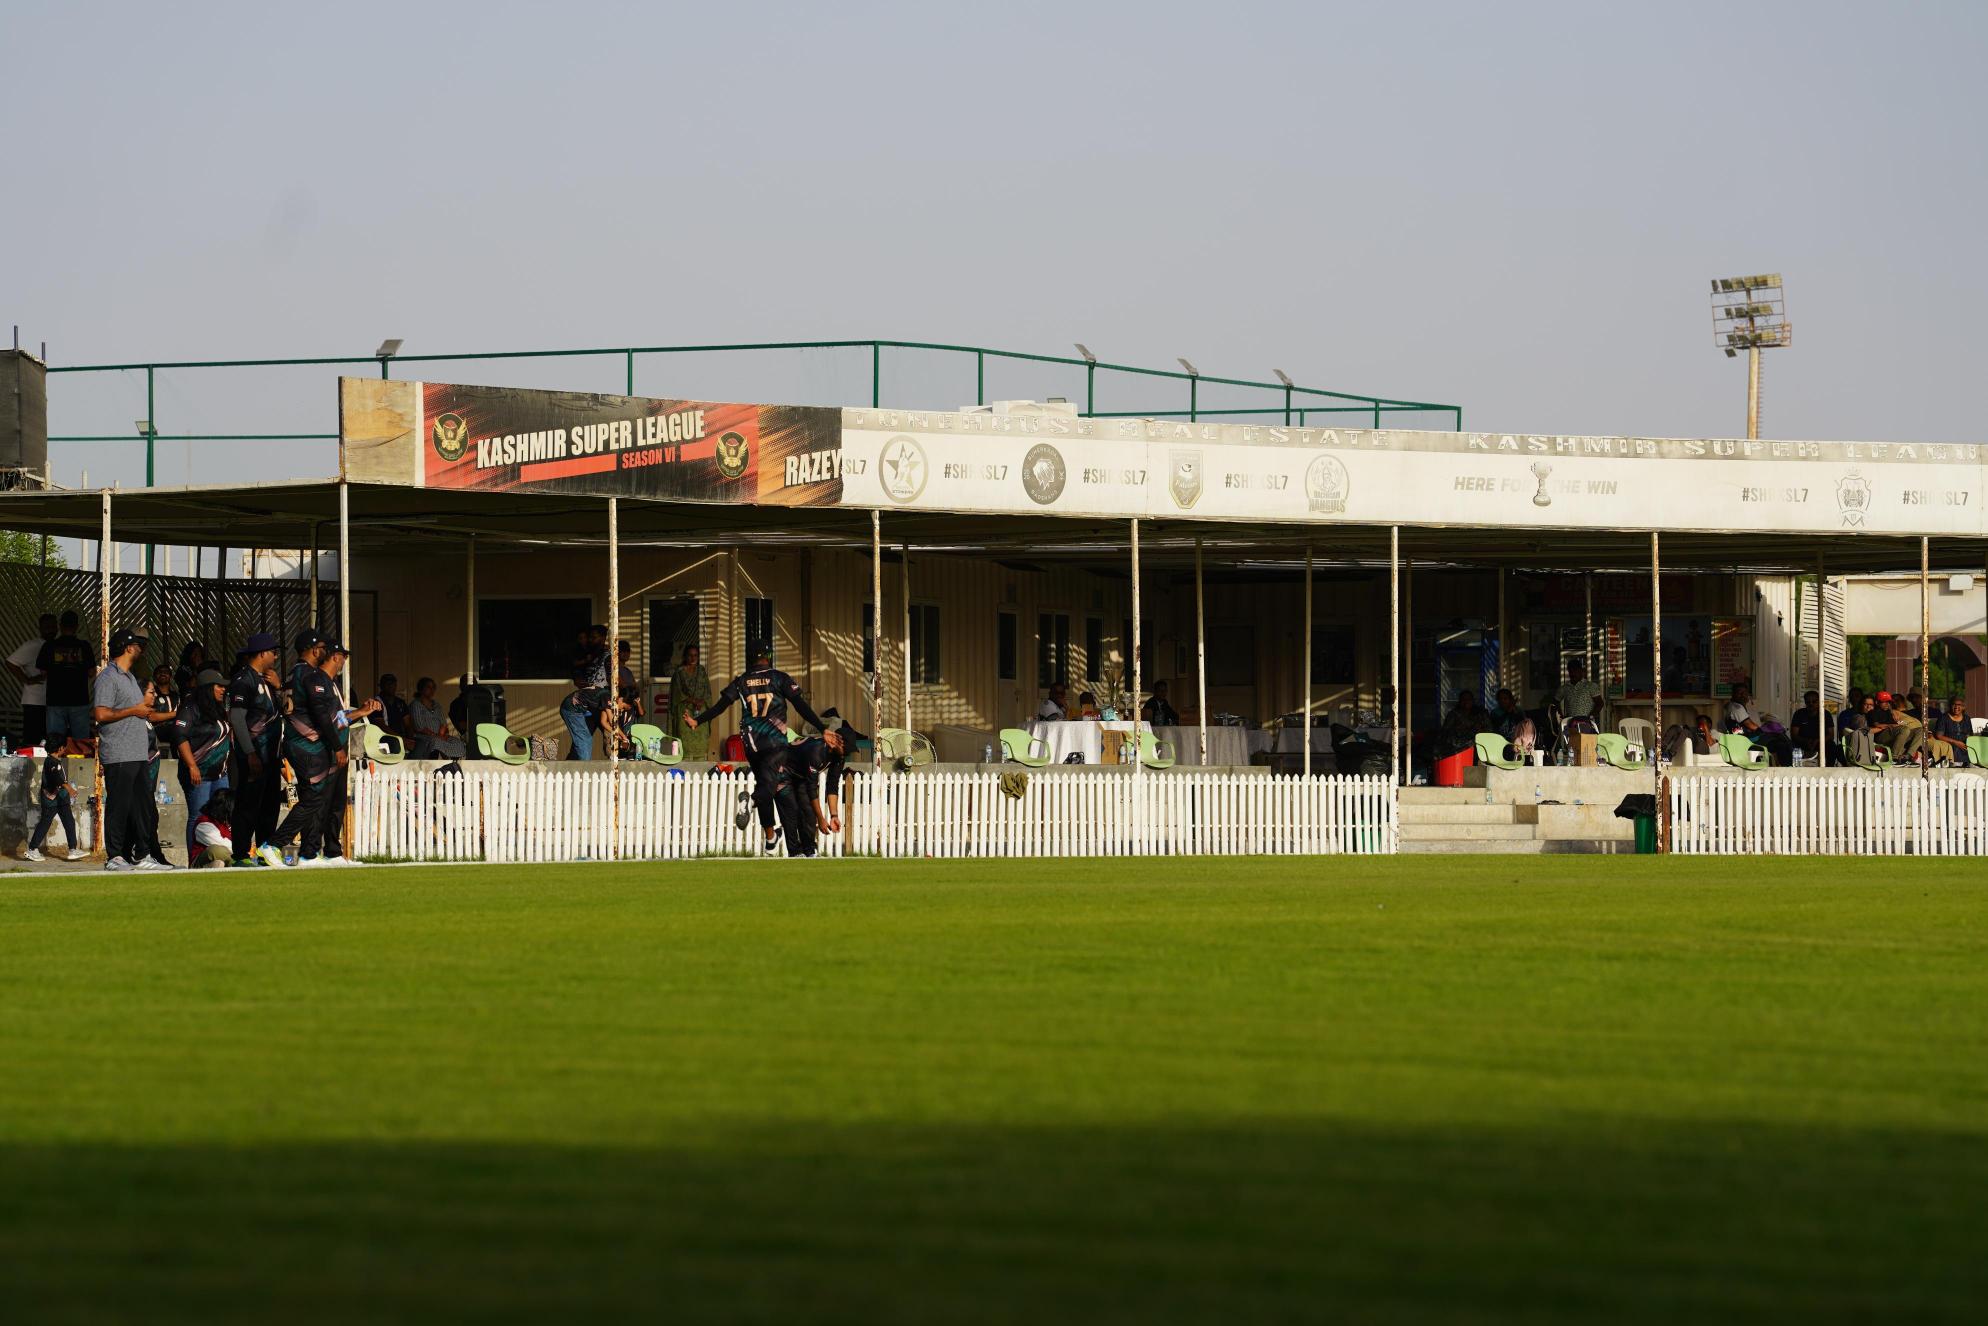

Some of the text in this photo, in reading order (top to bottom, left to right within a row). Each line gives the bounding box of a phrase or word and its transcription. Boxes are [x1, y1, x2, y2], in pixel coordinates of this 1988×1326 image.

[477, 410, 705, 469] KASHMIR SUPER LEAGUE
[1242, 426, 1388, 446] ESTATE
[1468, 434, 1656, 455] KASHMIR
[1684, 441, 1819, 457] SUPER
[622, 446, 676, 469] SEASON VI
[1453, 476, 1496, 492] HERE
[1552, 479, 1580, 495] THE
[1587, 480, 1618, 495] WIN
[747, 679, 771, 687] SHELLY
[747, 692, 774, 718] 17
